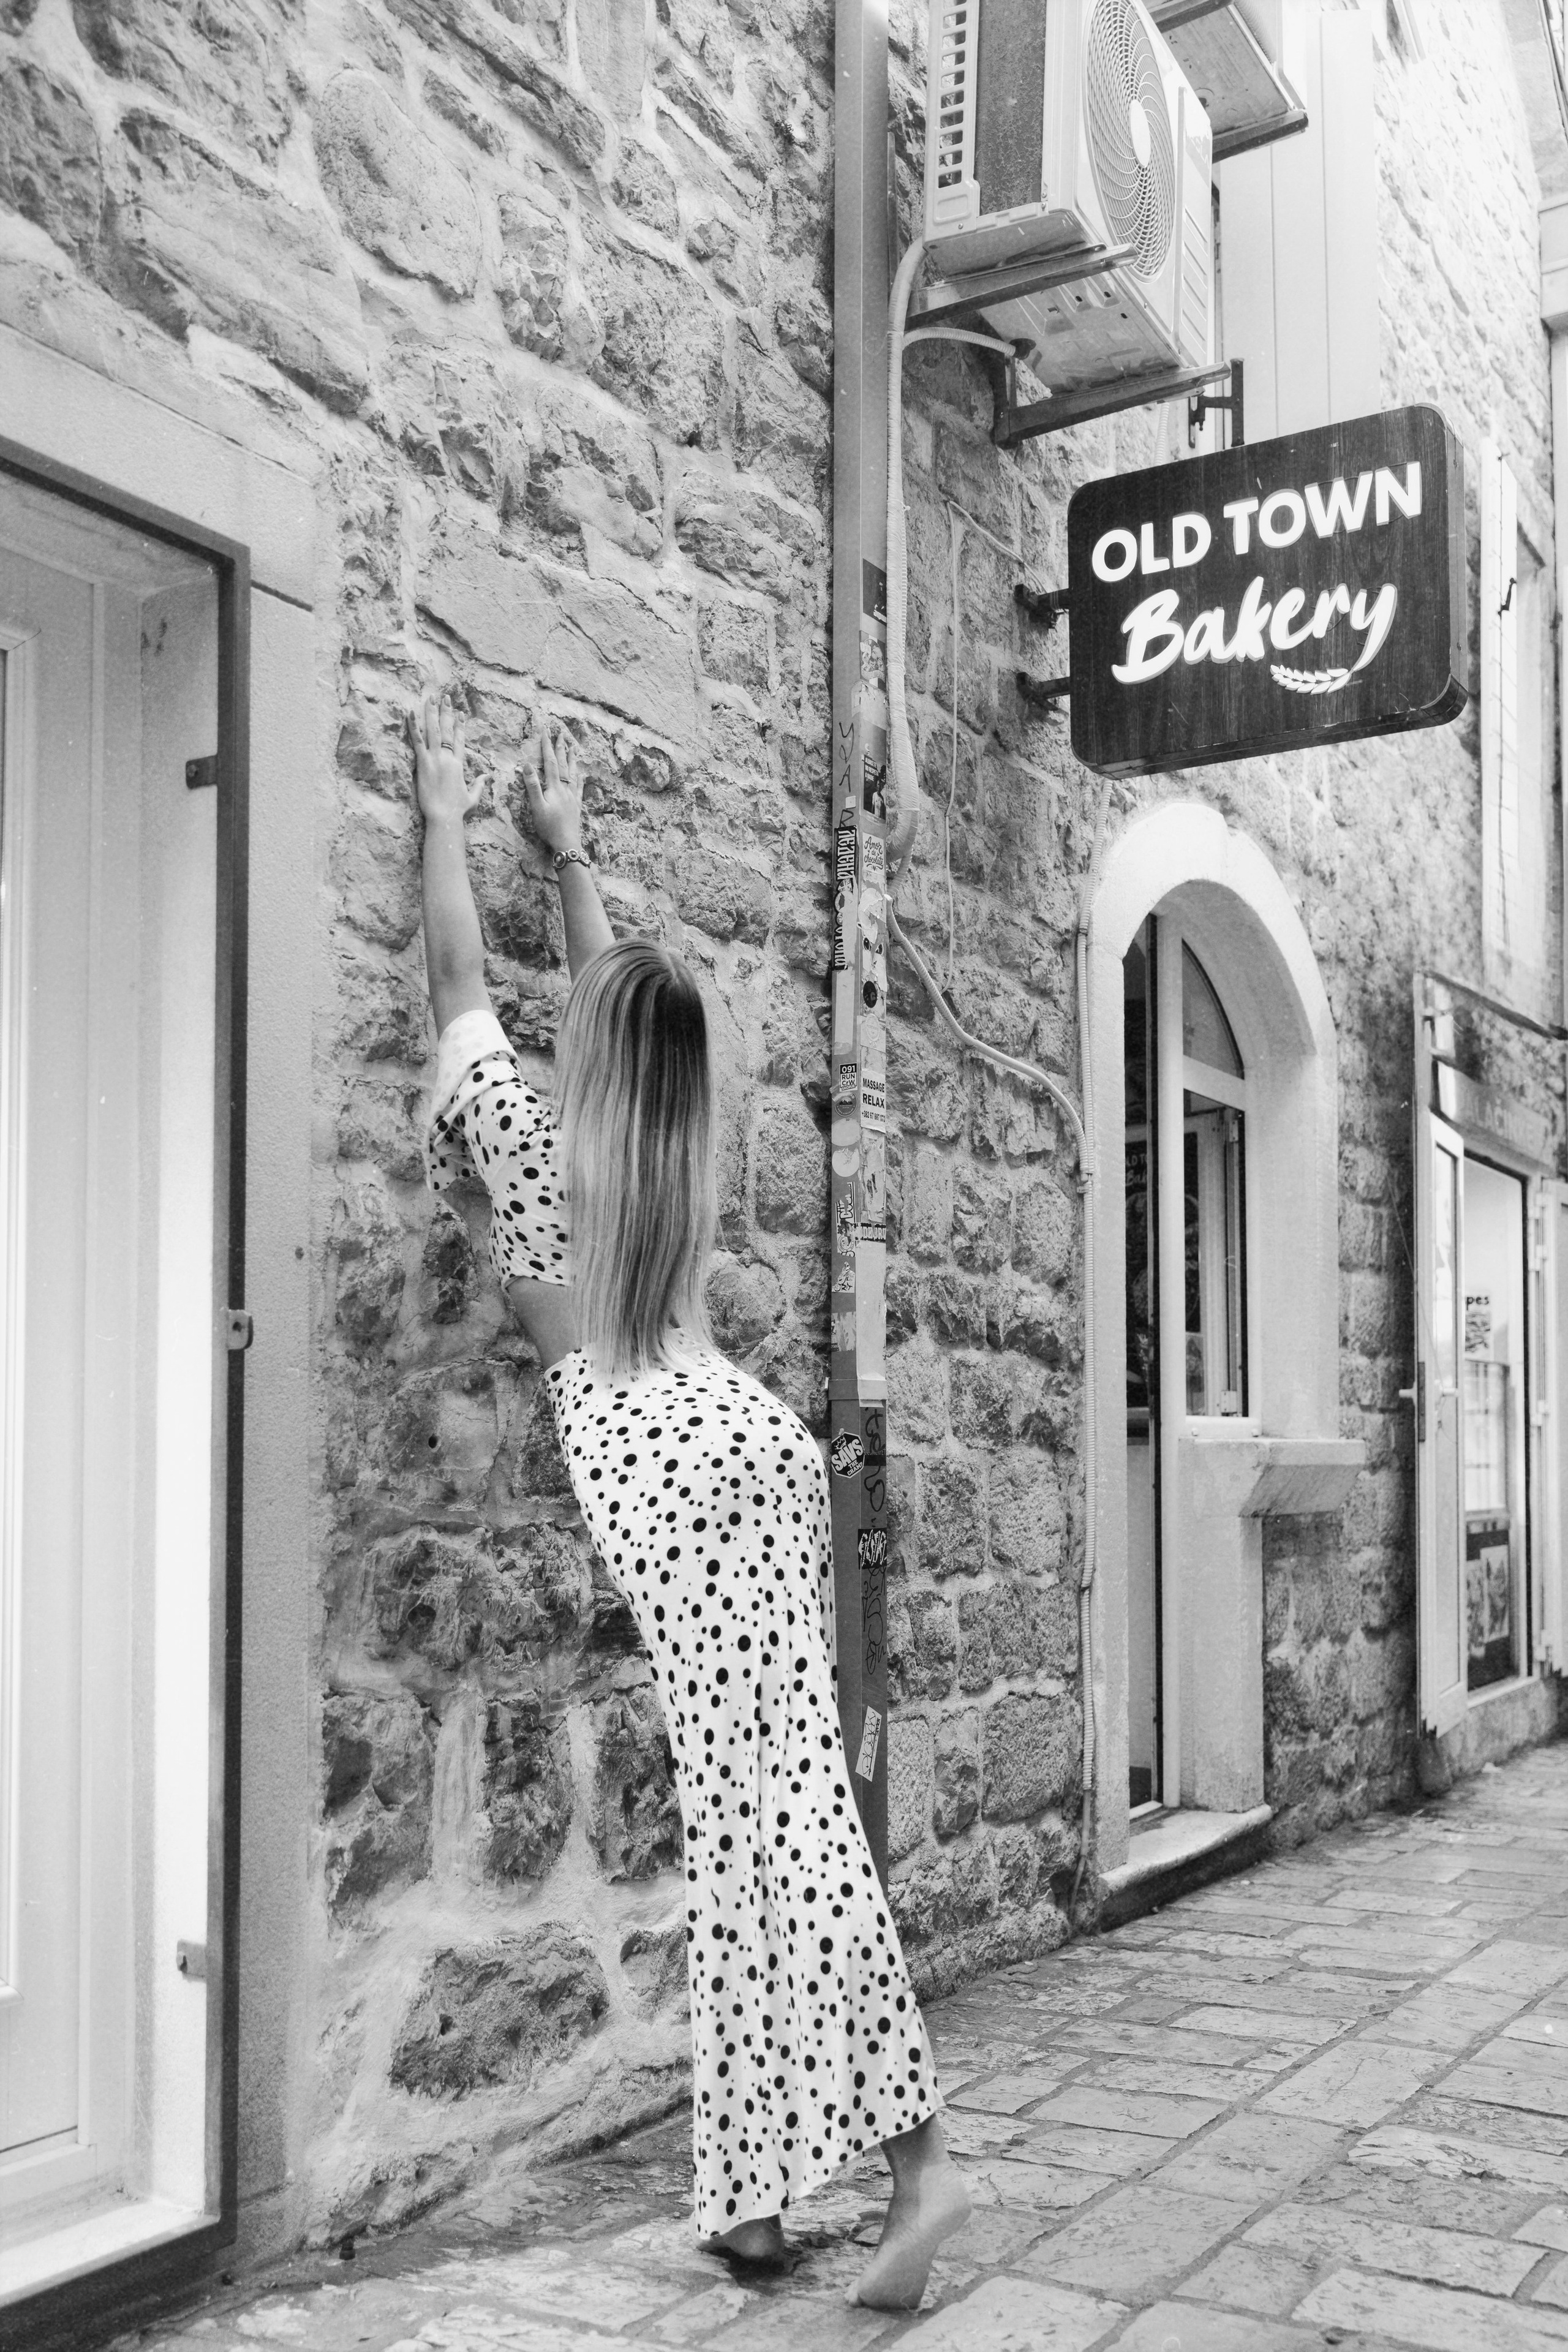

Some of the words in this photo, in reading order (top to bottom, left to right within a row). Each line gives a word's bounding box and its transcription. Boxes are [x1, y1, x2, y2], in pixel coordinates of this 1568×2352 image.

[1091, 512, 1212, 583] OLD
[1223, 461, 1422, 556] TOWN
[1111, 576, 1398, 685] Bakery
[864, 836, 883, 854] Amor
[864, 853, 884, 866] chocolate
[862, 1078, 885, 1093] MASSAGE
[862, 1093, 885, 1109] RELAX
[831, 1439, 864, 1471] SAVS
[847, 1461, 863, 1476] CHAMP
[848, 1460, 859, 1469] THE
